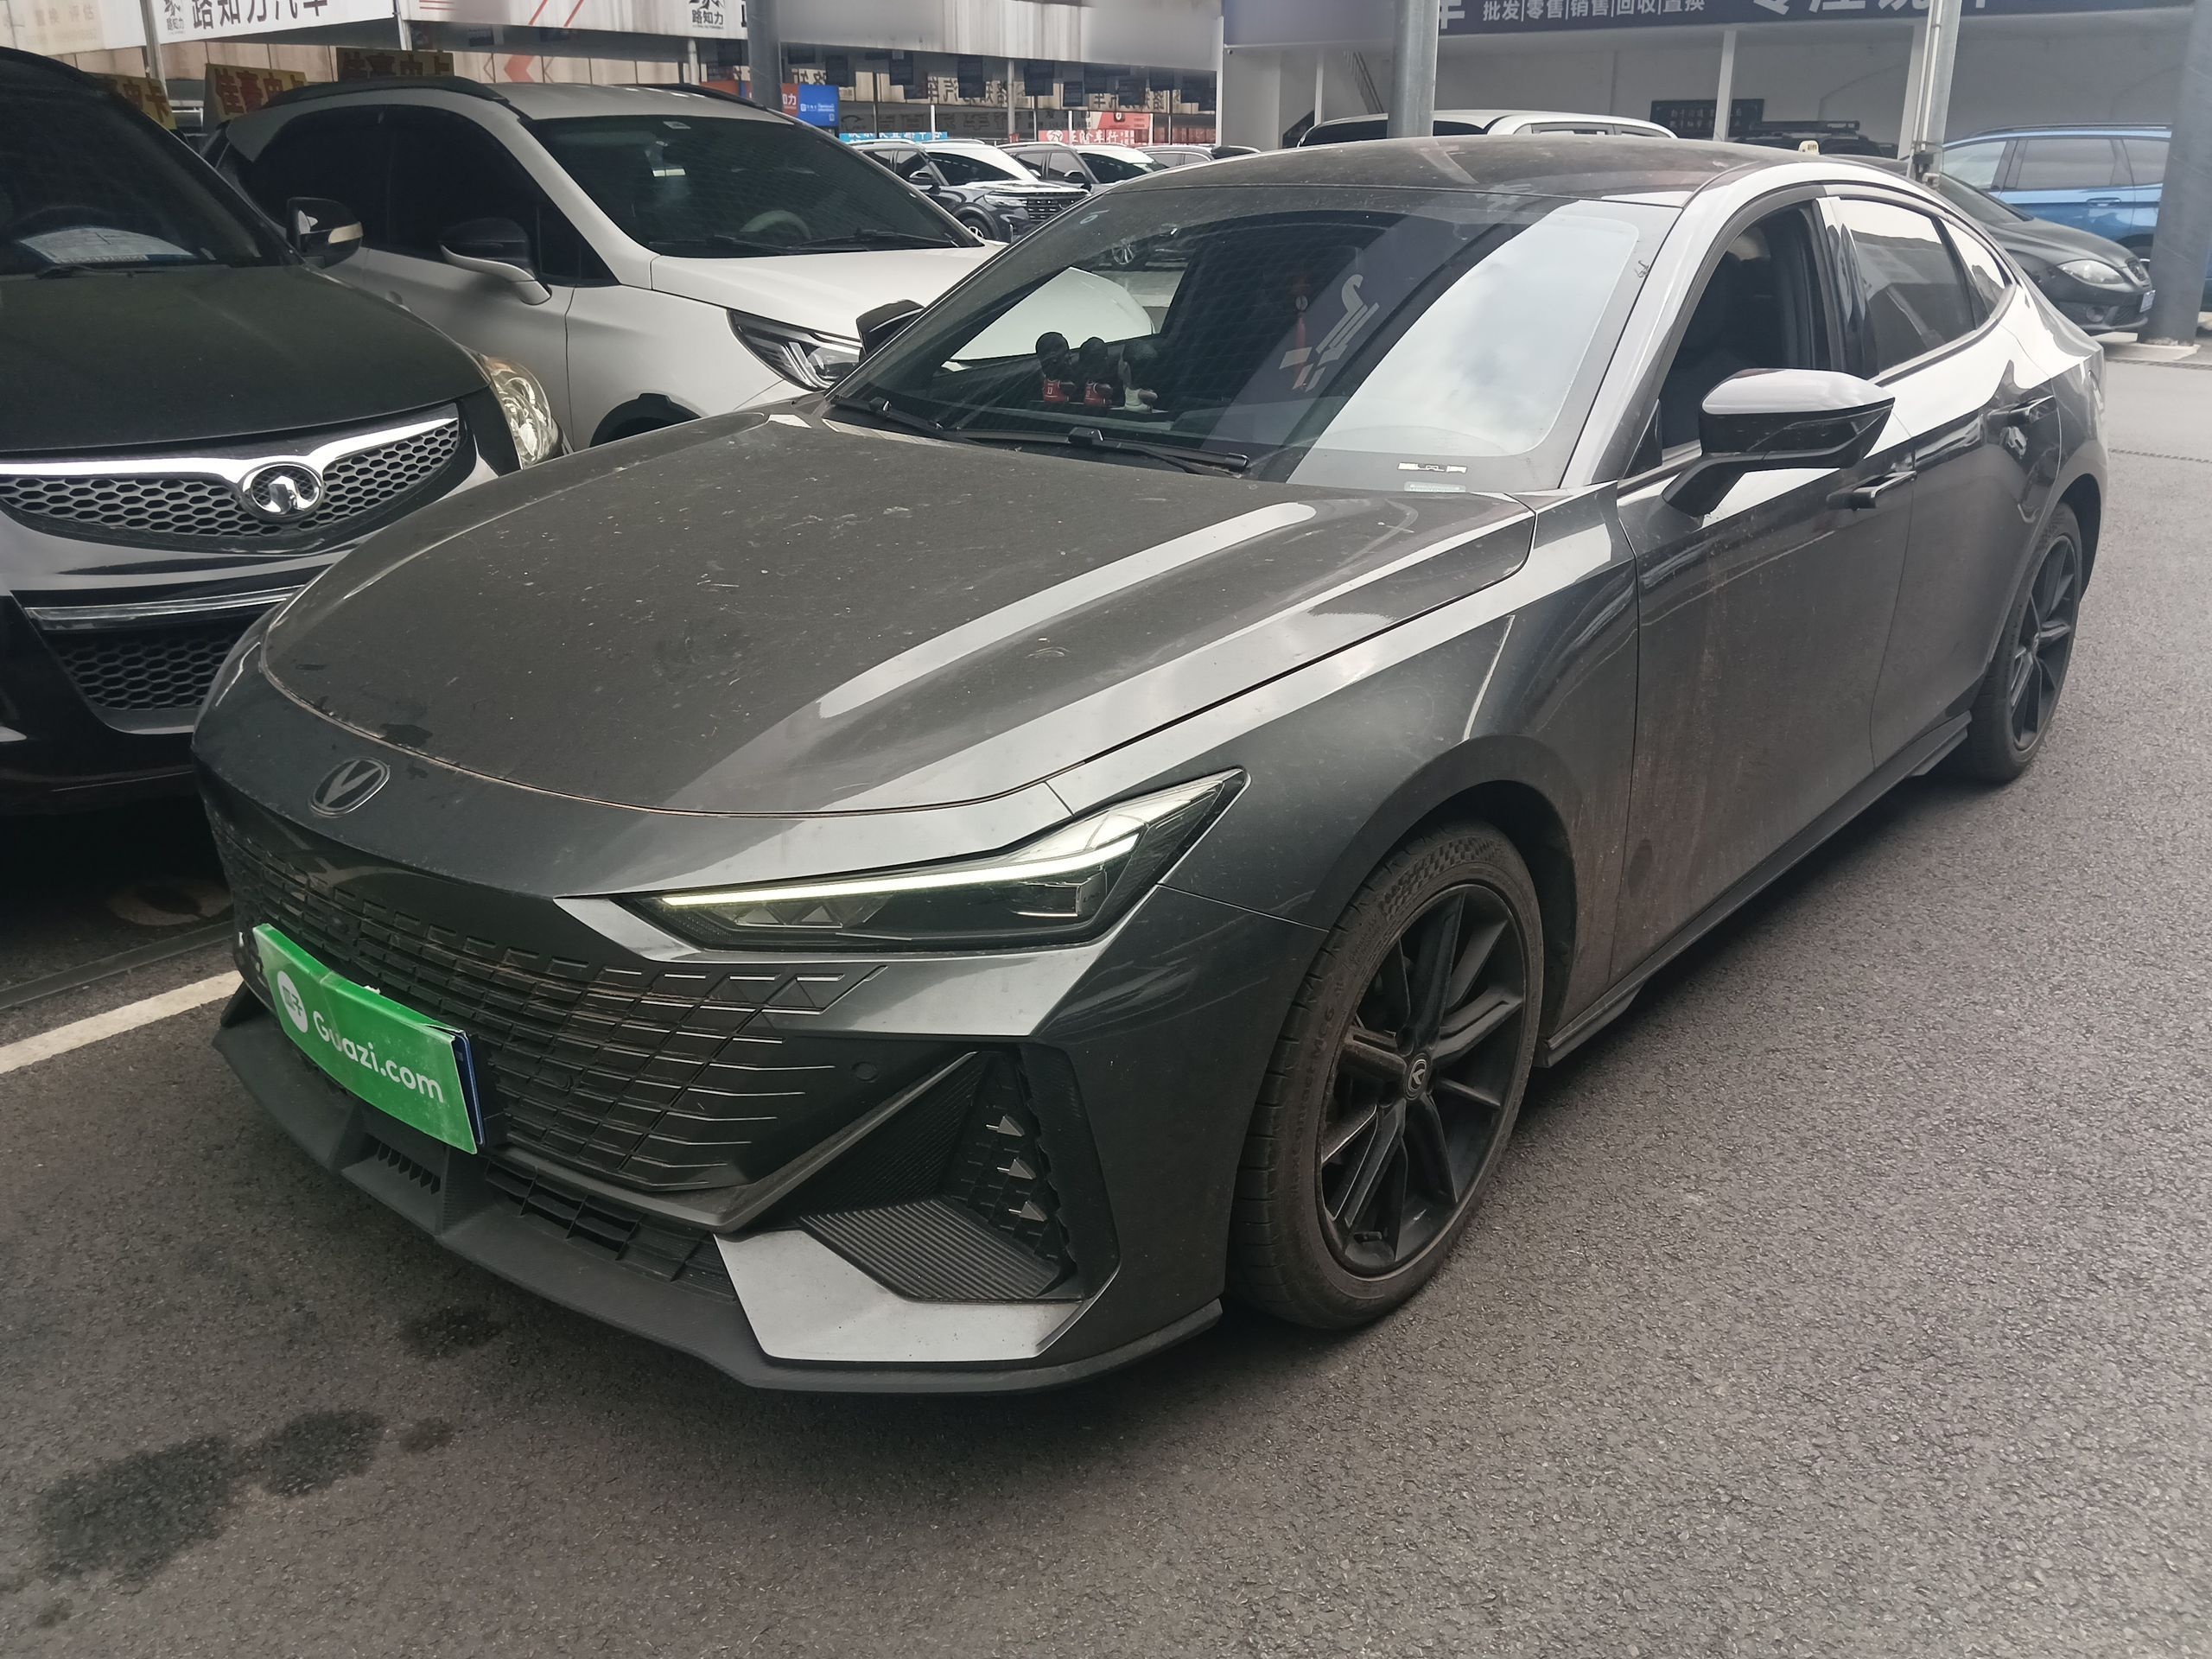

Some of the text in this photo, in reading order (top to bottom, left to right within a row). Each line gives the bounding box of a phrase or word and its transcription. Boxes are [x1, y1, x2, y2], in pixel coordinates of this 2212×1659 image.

[692, 10, 724, 25] 路知力
[313, 1010, 444, 1103] Guazi.com
